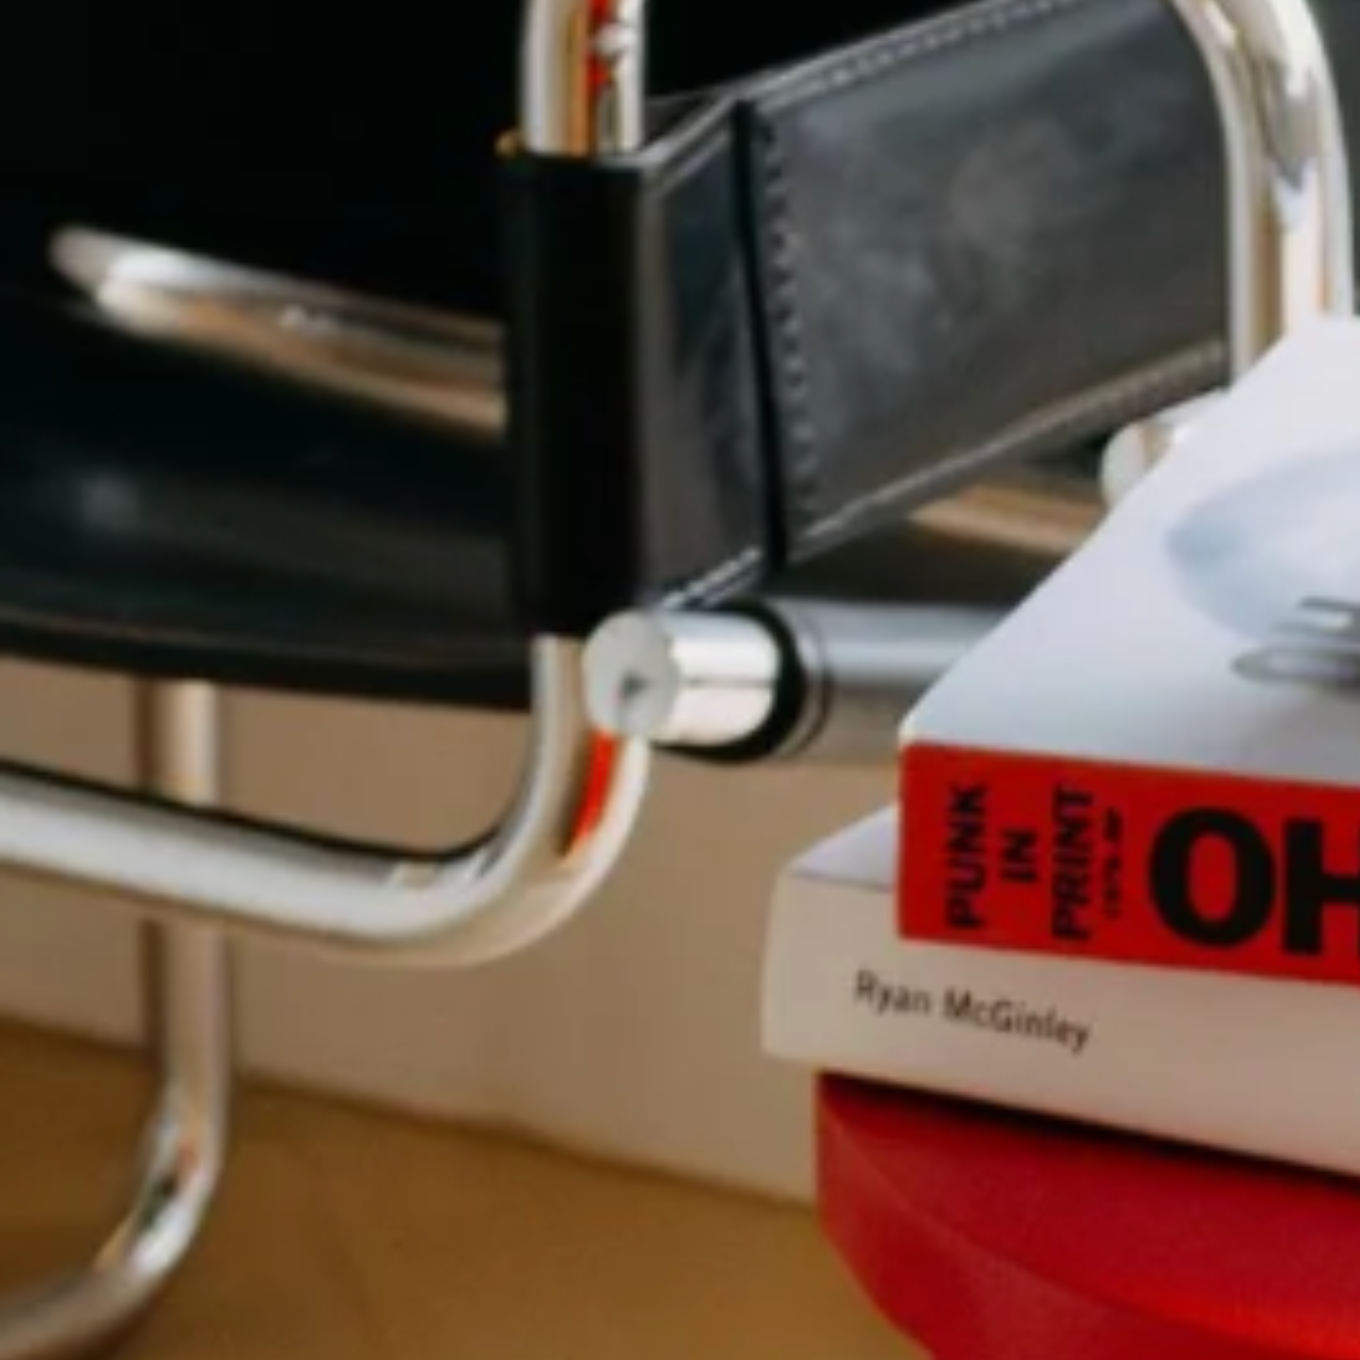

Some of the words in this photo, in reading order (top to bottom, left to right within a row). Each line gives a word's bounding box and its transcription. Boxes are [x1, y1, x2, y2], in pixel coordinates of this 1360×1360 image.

[947, 783, 989, 930] PUNK
[1000, 826, 1038, 883] IN
[1050, 786, 1094, 942] PRINT
[856, 968, 932, 1018] Ryan
[944, 986, 1091, 1058] McGinley
